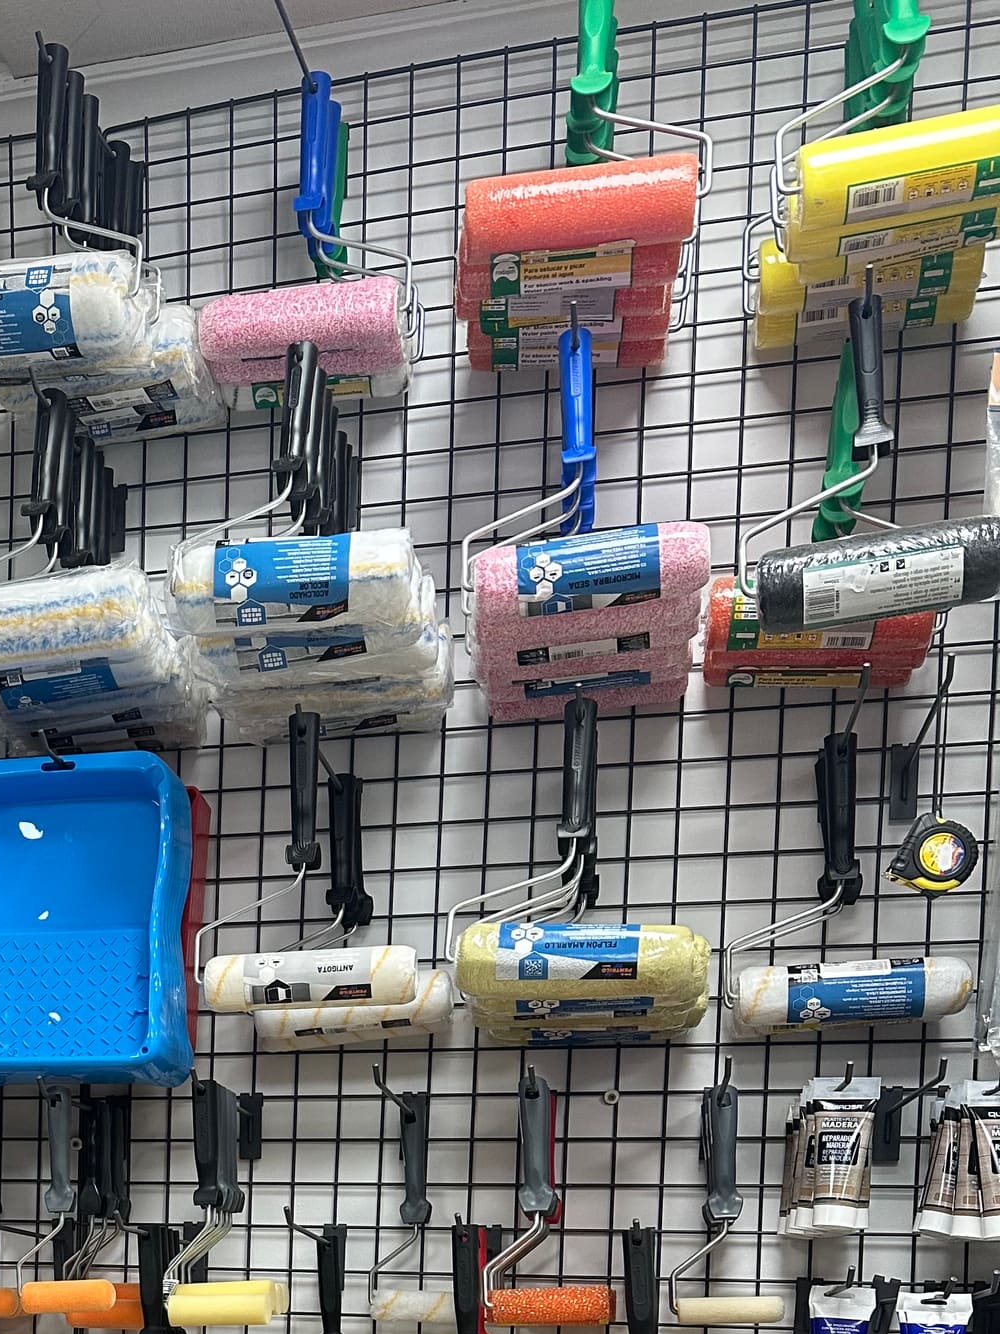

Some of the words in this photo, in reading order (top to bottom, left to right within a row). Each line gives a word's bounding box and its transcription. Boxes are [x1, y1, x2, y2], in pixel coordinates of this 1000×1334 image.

[539, 264, 563, 272] estucar
[570, 263, 586, 271] picar
[524, 273, 548, 281] Pinturas
[558, 271, 574, 279] agua
[581, 276, 613, 284] spackling
[568, 579, 590, 590] SEDA
[594, 572, 641, 587] MICROFIBRA
[543, 940, 582, 953] AMARILLO
[316, 963, 354, 974] ANTIGOTA
[821, 1121, 859, 1129] MADERA
